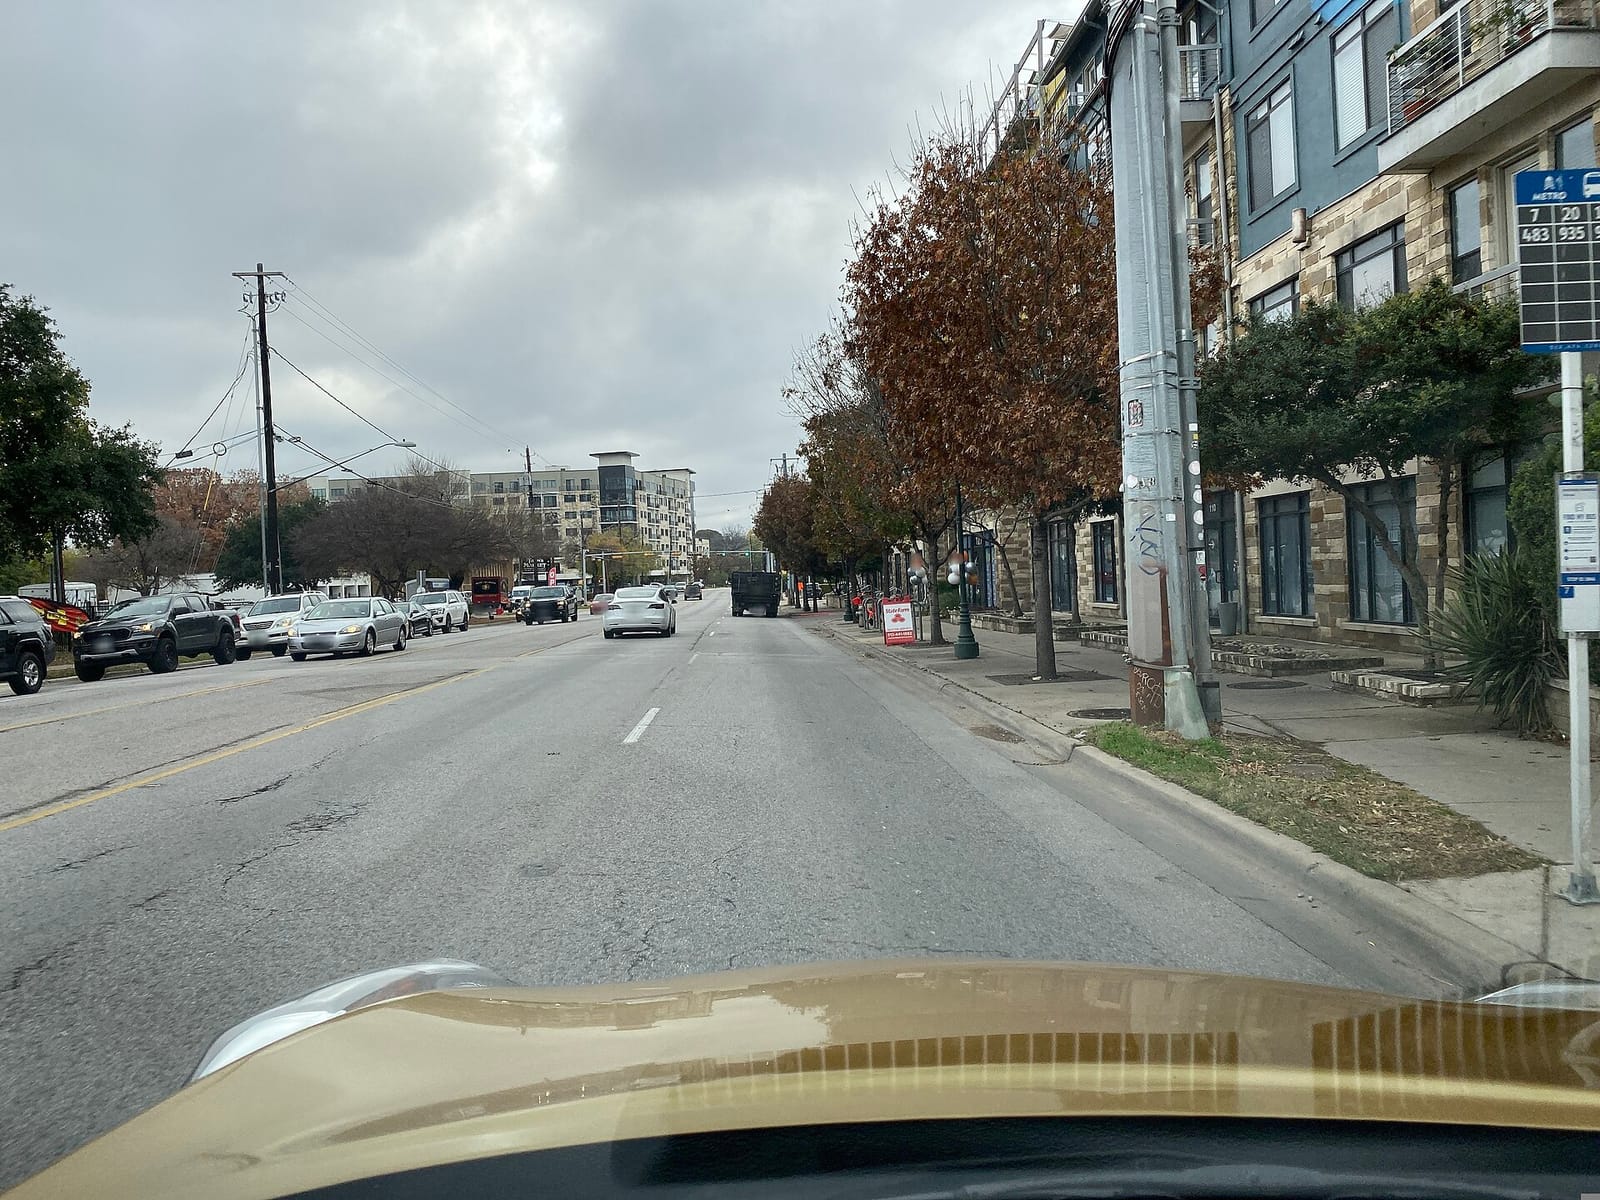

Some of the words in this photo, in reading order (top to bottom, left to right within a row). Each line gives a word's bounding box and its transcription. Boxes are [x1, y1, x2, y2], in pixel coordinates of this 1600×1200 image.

[1532, 191, 1567, 200] METRO
[1529, 208, 1539, 222] 7
[1561, 206, 1580, 221] 20
[1522, 227, 1550, 242] 483
[1559, 226, 1585, 240] 935
